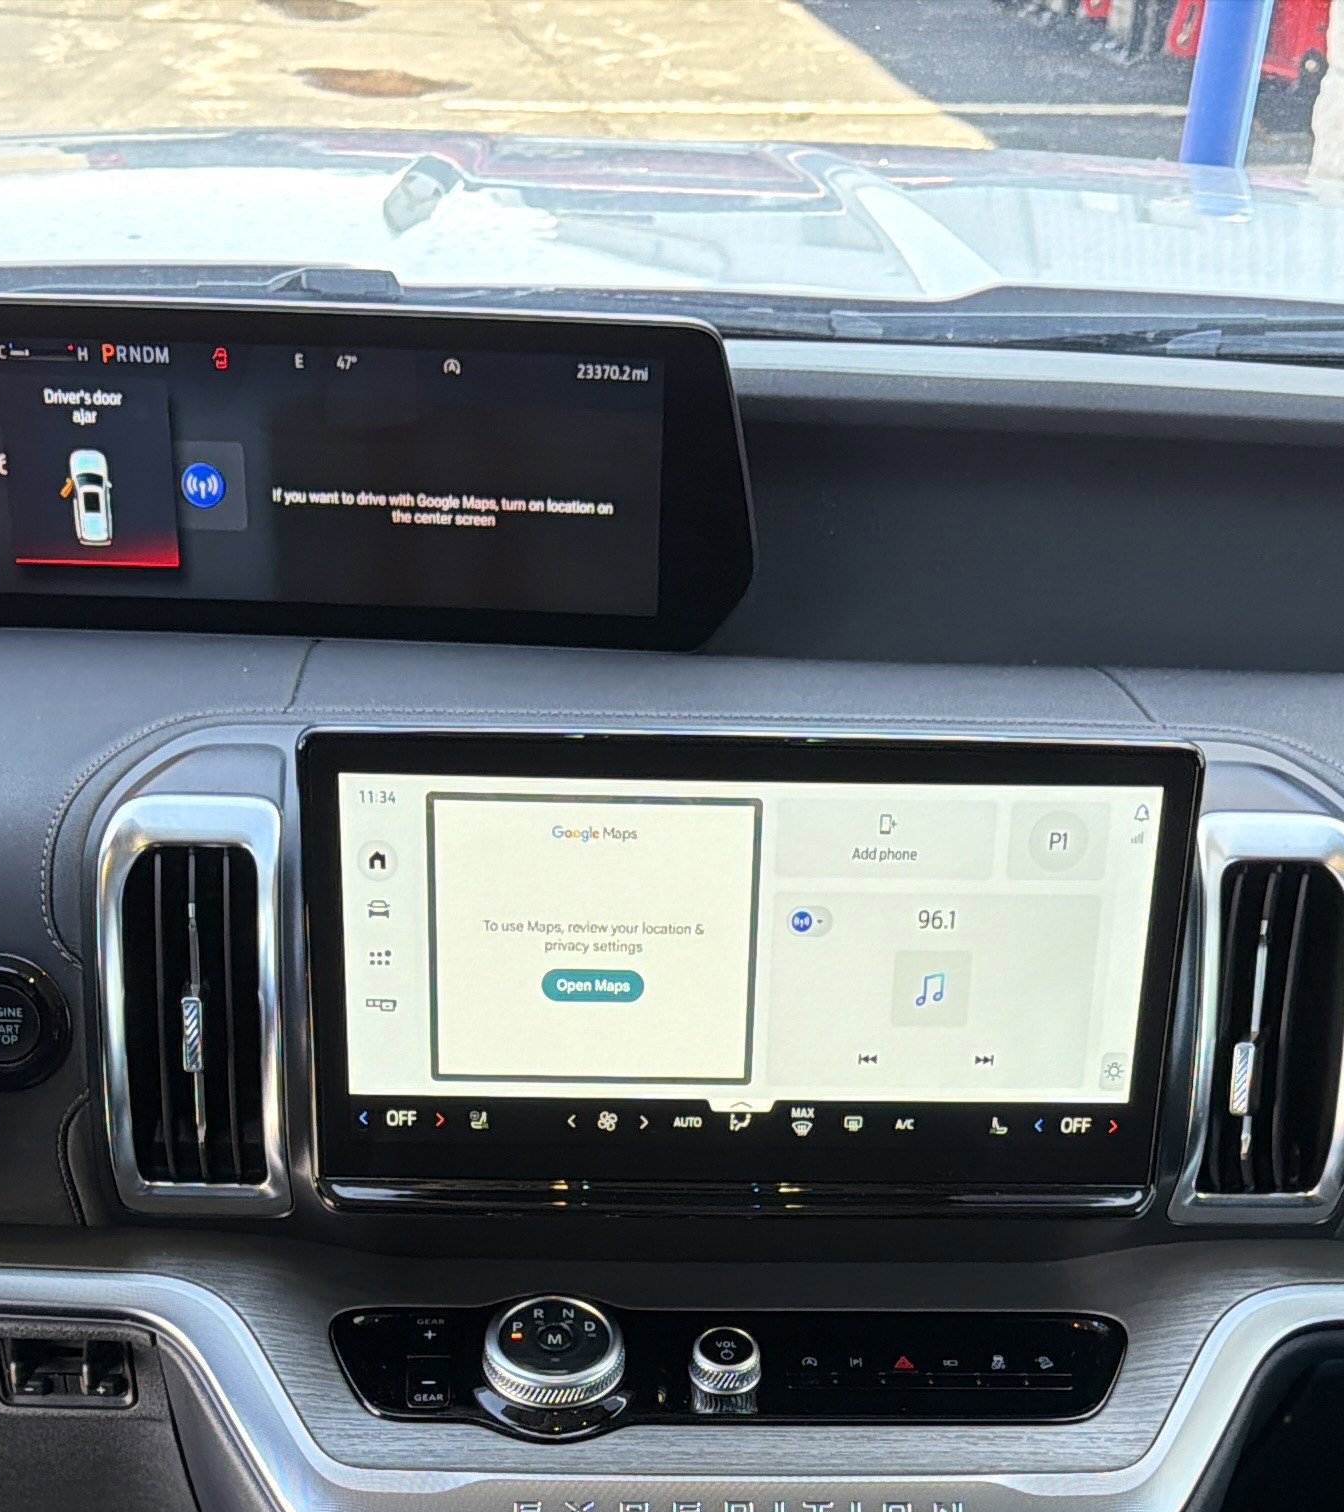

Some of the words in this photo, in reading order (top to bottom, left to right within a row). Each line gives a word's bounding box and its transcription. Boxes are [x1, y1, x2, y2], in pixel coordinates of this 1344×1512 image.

[294, 353, 304, 369] E
[44, 388, 91, 406] Driver's
[92, 390, 123, 406] door
[72, 409, 98, 425] ajar
[272, 488, 282, 503] If
[284, 491, 306, 506] you
[309, 491, 339, 505] want
[341, 492, 355, 505] to
[356, 491, 386, 506] drive
[388, 493, 415, 508] with
[416, 493, 460, 511] Google
[462, 496, 499, 513] Maps,
[501, 498, 526, 511] turn
[528, 501, 544, 512] on
[546, 498, 595, 514] location
[597, 502, 613, 515] on
[392, 511, 412, 524] the
[414, 512, 453, 526] center
[455, 514, 496, 527] screen
[358, 790, 396, 804] 11:34
[552, 825, 599, 842] Google
[602, 826, 638, 842] Maps
[851, 847, 877, 861] Add
[879, 847, 918, 863] phone
[918, 909, 956, 930] 96.1
[483, 920, 498, 933] To
[501, 922, 524, 933] use
[527, 921, 565, 936] Maps,
[567, 922, 608, 934] review
[610, 924, 639, 937] your
[642, 922, 692, 936] location
[694, 924, 705, 935] &
[544, 940, 589, 954] privacy
[592, 940, 643, 954] settings
[556, 979, 592, 994] Open
[594, 979, 631, 994] Maps
[386, 1109, 417, 1127] OFF
[791, 1107, 815, 1119] MAX
[673, 1116, 703, 1128] AUTO
[894, 1118, 915, 1130] A/C
[1060, 1117, 1092, 1134] OFF
[416, 1318, 445, 1326] GEAR
[512, 1321, 523, 1332] P
[547, 1333, 562, 1345] M
[715, 1340, 737, 1349] VOL
[413, 1393, 444, 1402] GEAR
